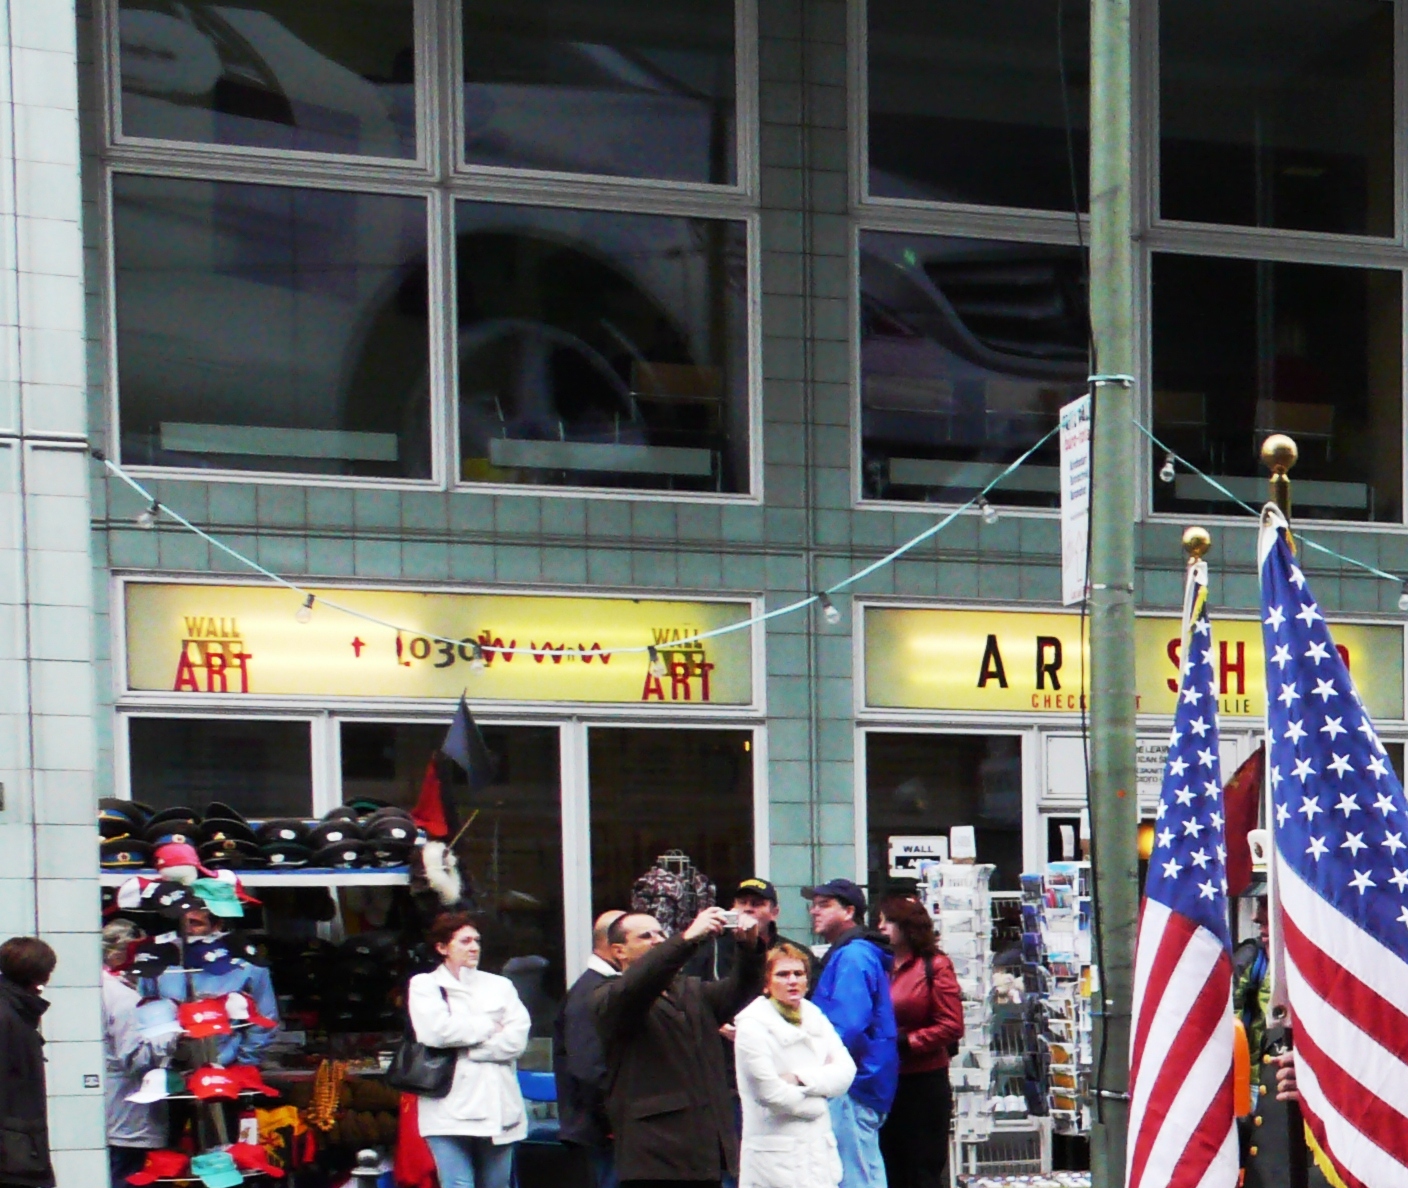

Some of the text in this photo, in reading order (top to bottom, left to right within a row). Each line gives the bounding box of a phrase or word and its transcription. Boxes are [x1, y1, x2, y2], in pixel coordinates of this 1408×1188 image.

[184, 616, 240, 638] WALL
[652, 627, 703, 651] WALL
[173, 649, 253, 693] ART
[977, 633, 1063, 691] AR
[642, 662, 715, 701] ART
[902, 844, 934, 854] WALL
